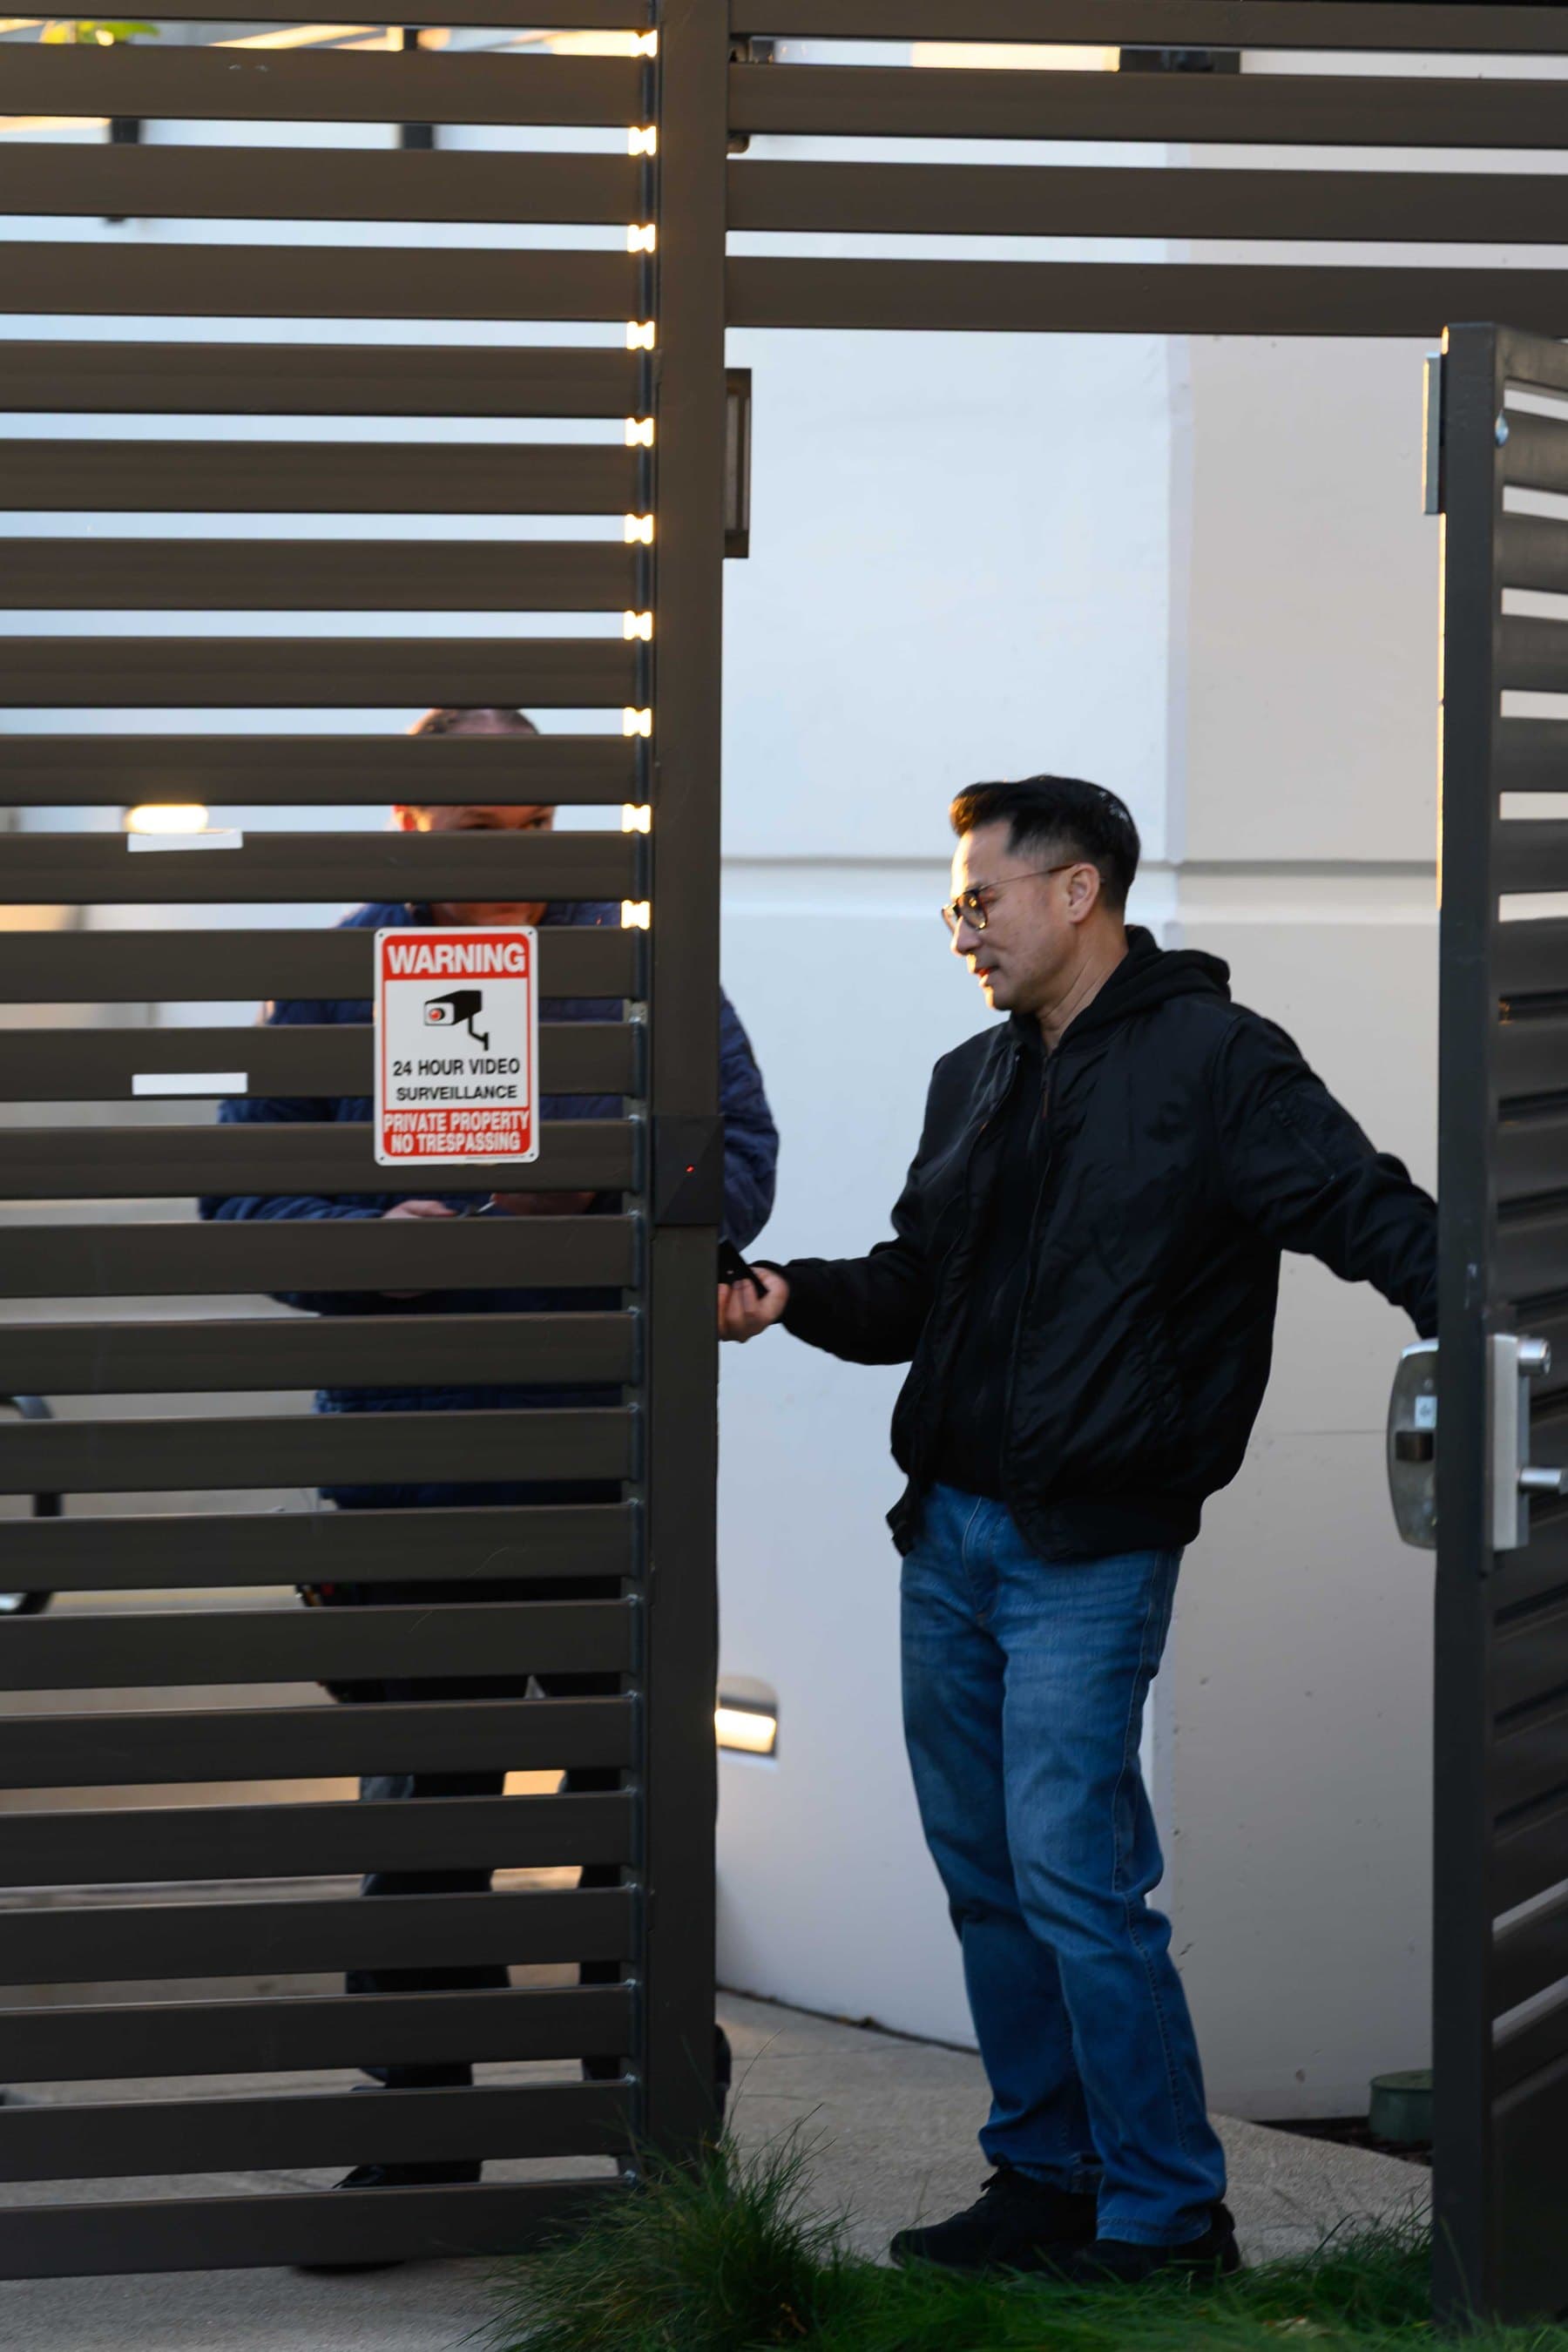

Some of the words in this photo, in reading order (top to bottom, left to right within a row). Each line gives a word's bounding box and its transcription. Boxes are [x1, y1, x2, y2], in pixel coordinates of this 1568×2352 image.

[388, 943, 526, 974] WARNING
[393, 1060, 412, 1076] 24
[418, 1059, 463, 1076] HOUR
[469, 1058, 520, 1074] VIDEO
[396, 1085, 517, 1100] SURVEILLANCE
[384, 1112, 448, 1132] PRIVATE
[450, 1110, 530, 1131] PROPERTY
[391, 1134, 414, 1153] NO
[416, 1132, 521, 1152] TRESPASSING
